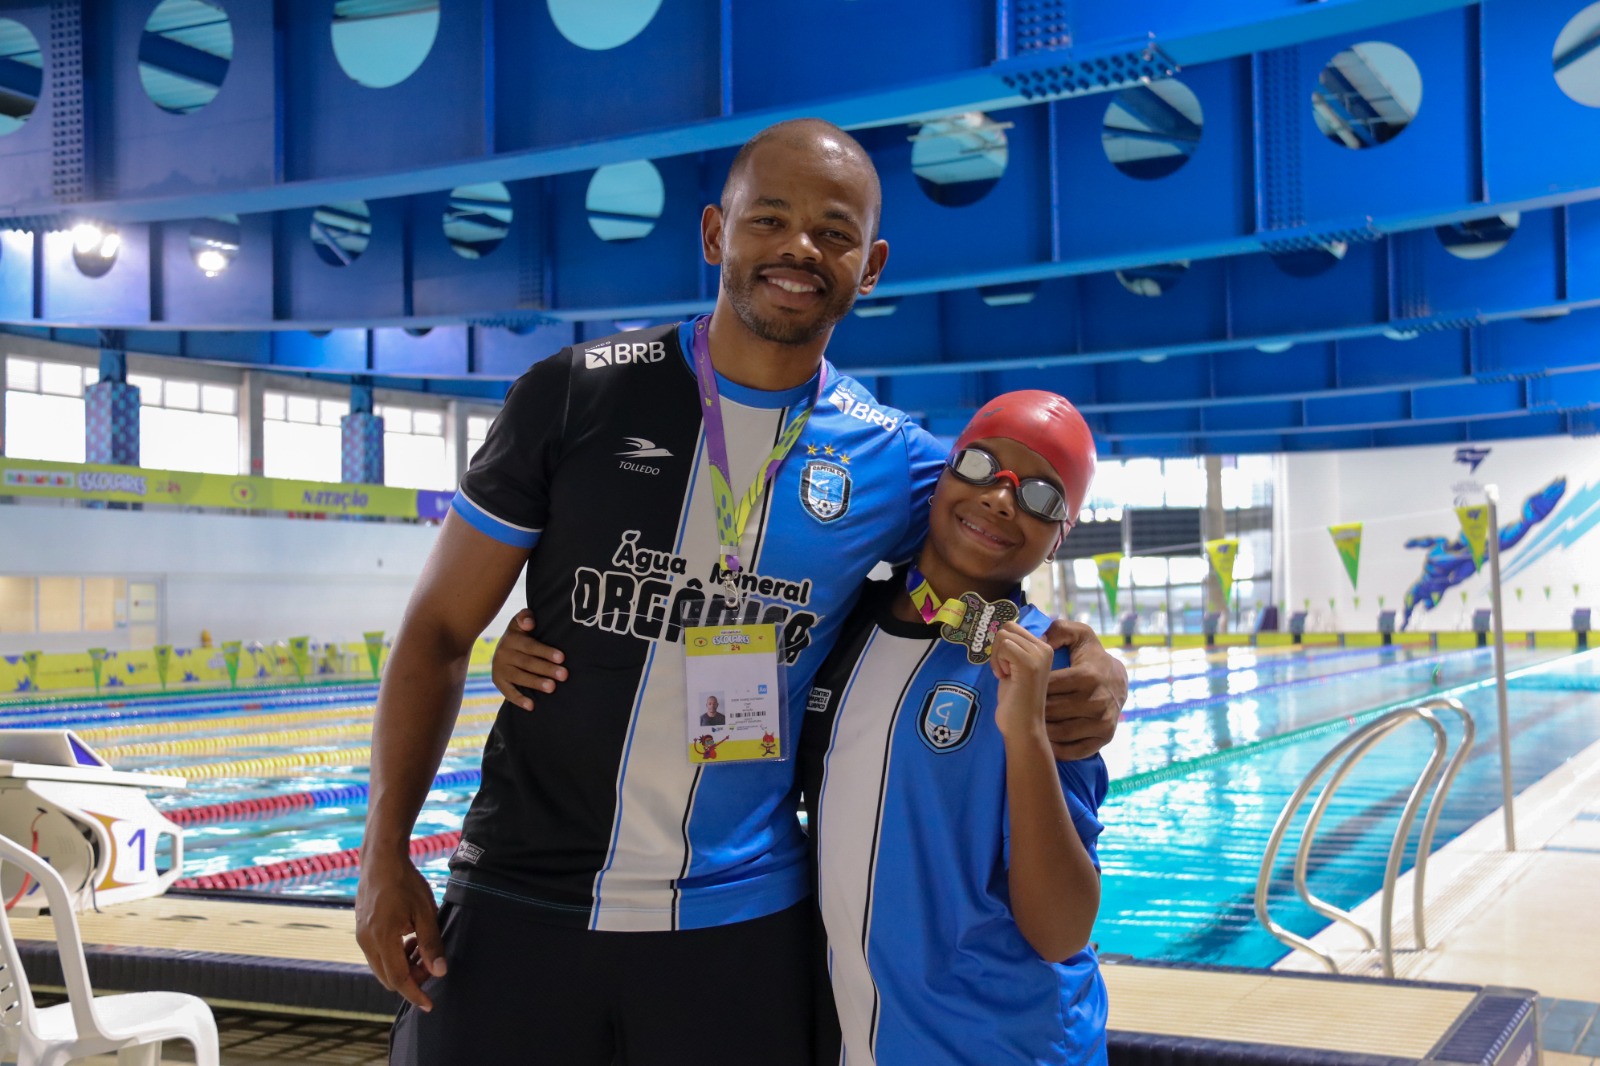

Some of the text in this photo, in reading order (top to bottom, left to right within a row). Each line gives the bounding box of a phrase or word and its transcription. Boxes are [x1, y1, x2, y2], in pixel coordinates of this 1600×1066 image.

[615, 341, 666, 364] BRB
[618, 461, 660, 475] TOLLEDO
[613, 531, 687, 575] Água
[712, 635, 750, 645] ESCOLARES
[971, 603, 996, 653] ESCOLARES
[127, 828, 146, 872] 1
